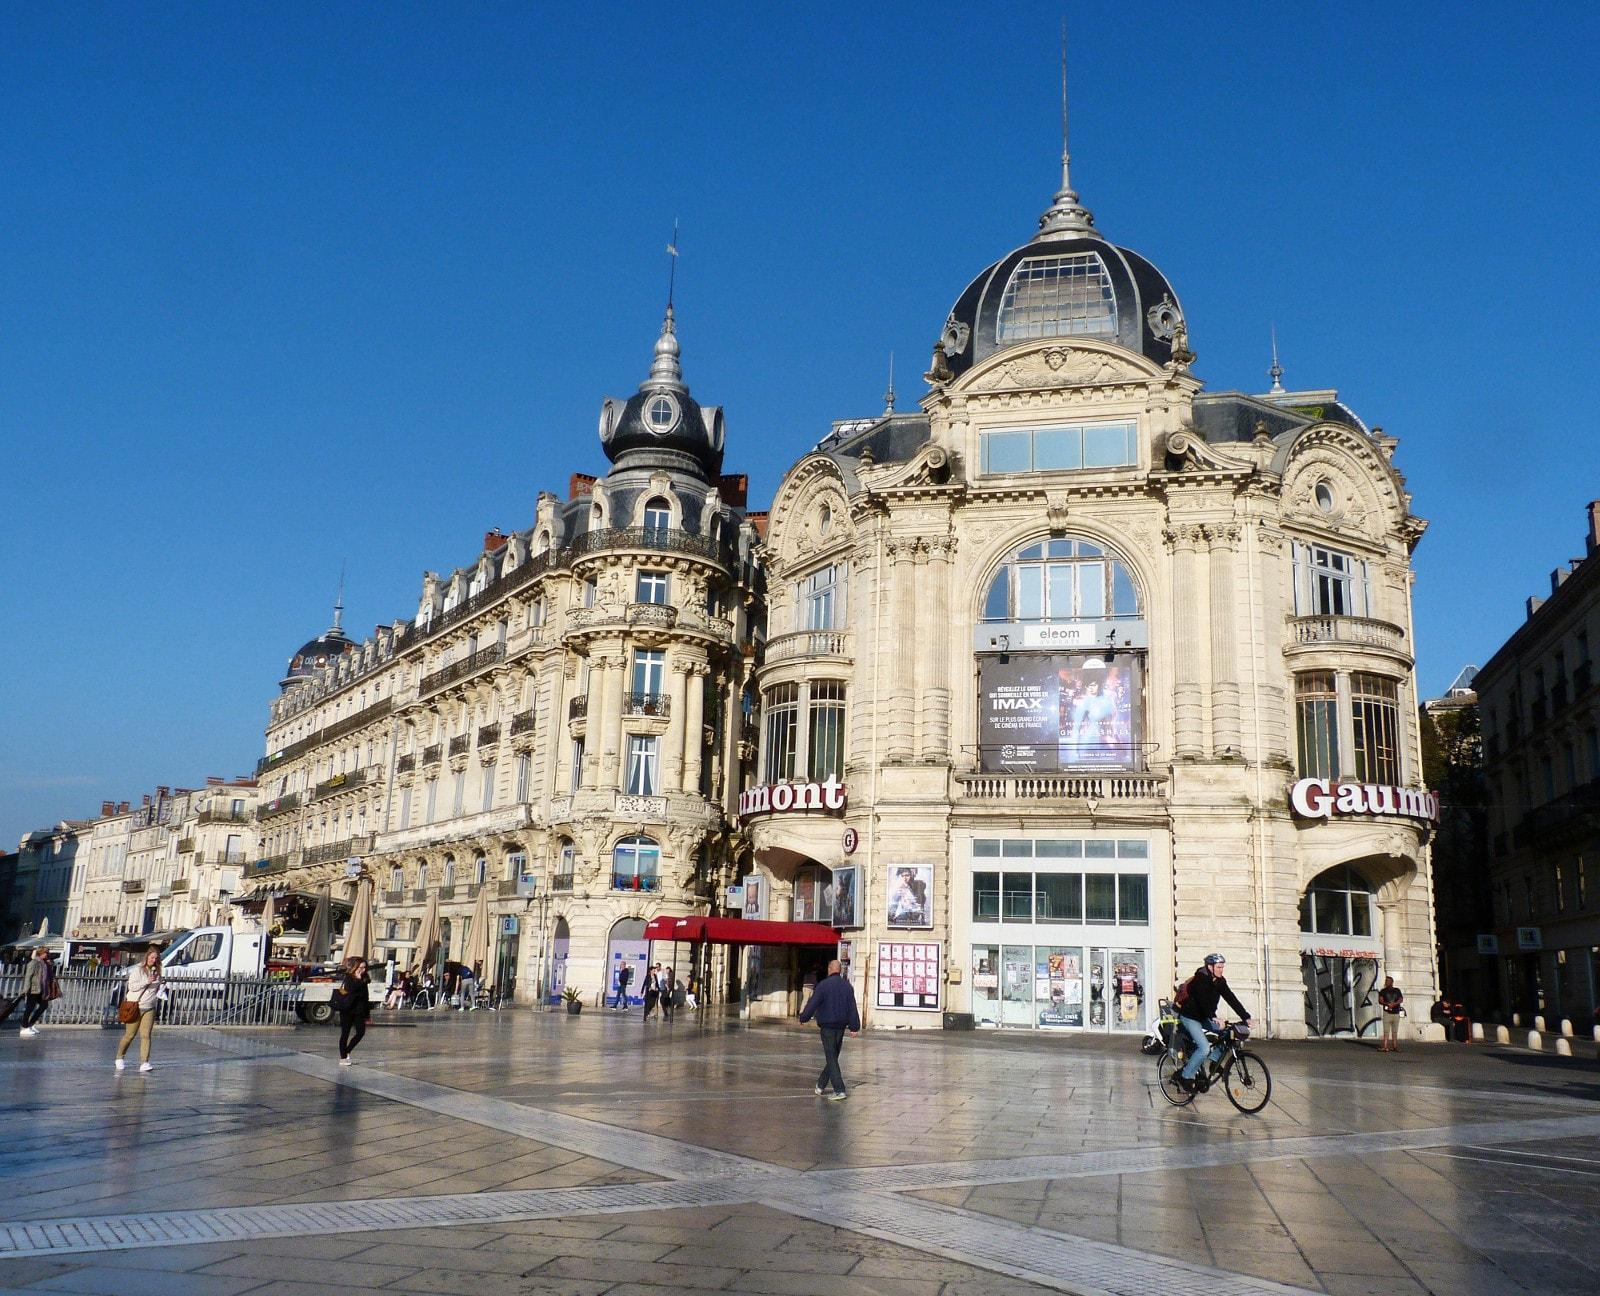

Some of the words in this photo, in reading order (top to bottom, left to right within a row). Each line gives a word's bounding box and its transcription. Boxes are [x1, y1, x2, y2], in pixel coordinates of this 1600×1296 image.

[1040, 627, 1080, 639] eleom
[993, 698, 1042, 710] IMAX
[1292, 778, 1437, 821] Gaumo
